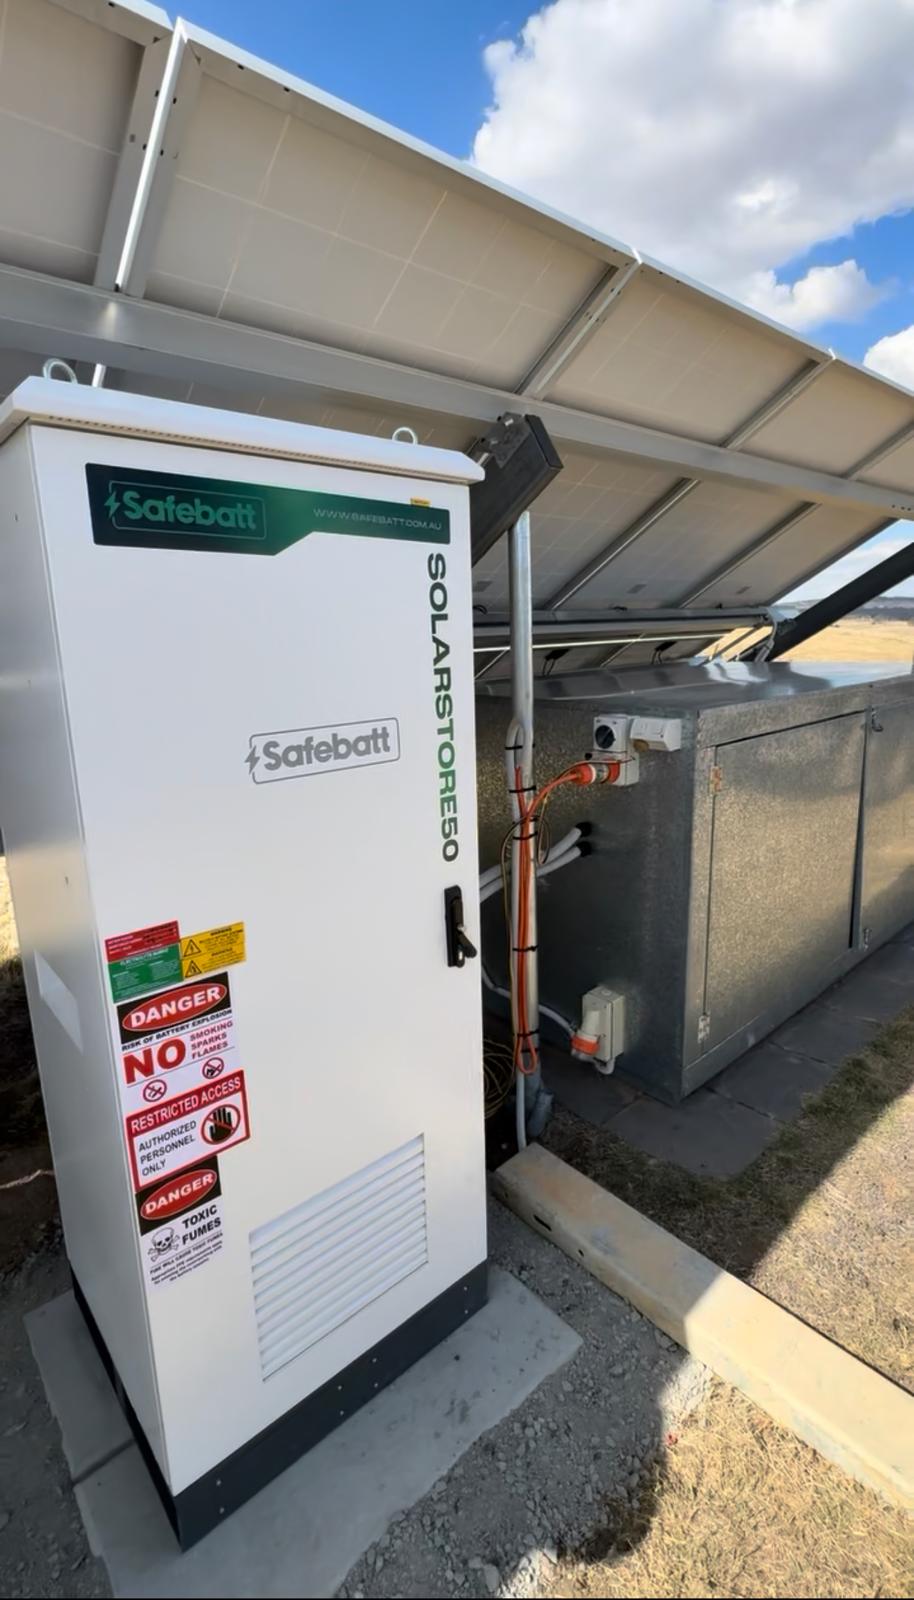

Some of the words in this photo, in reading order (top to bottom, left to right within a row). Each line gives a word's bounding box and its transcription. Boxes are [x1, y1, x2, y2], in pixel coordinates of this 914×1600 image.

[122, 490, 257, 529] Safebatt
[427, 552, 459, 862] SOLARSTORE50
[262, 726, 391, 771] Safebatt
[130, 986, 221, 1028] DANGER
[122, 1042, 141, 1052] RISK
[143, 1036, 154, 1045] OF
[156, 1024, 190, 1041] BATTERY
[192, 1009, 233, 1027] EXPLOSION
[190, 1020, 233, 1042] SMOKING
[191, 1033, 228, 1050] SPARKS
[123, 1038, 187, 1085] NO
[191, 1042, 229, 1060] FLAMES
[130, 1095, 200, 1134] RESTRICTED
[200, 1077, 241, 1105] ACCESS
[138, 1120, 197, 1152] AUTHORIZED
[140, 1134, 196, 1164] PERSONNEL
[141, 1160, 166, 1177] ONLY
[144, 1173, 214, 1215] DANGER
[182, 1204, 218, 1229] TOXIC
[182, 1217, 222, 1245] FUMES
